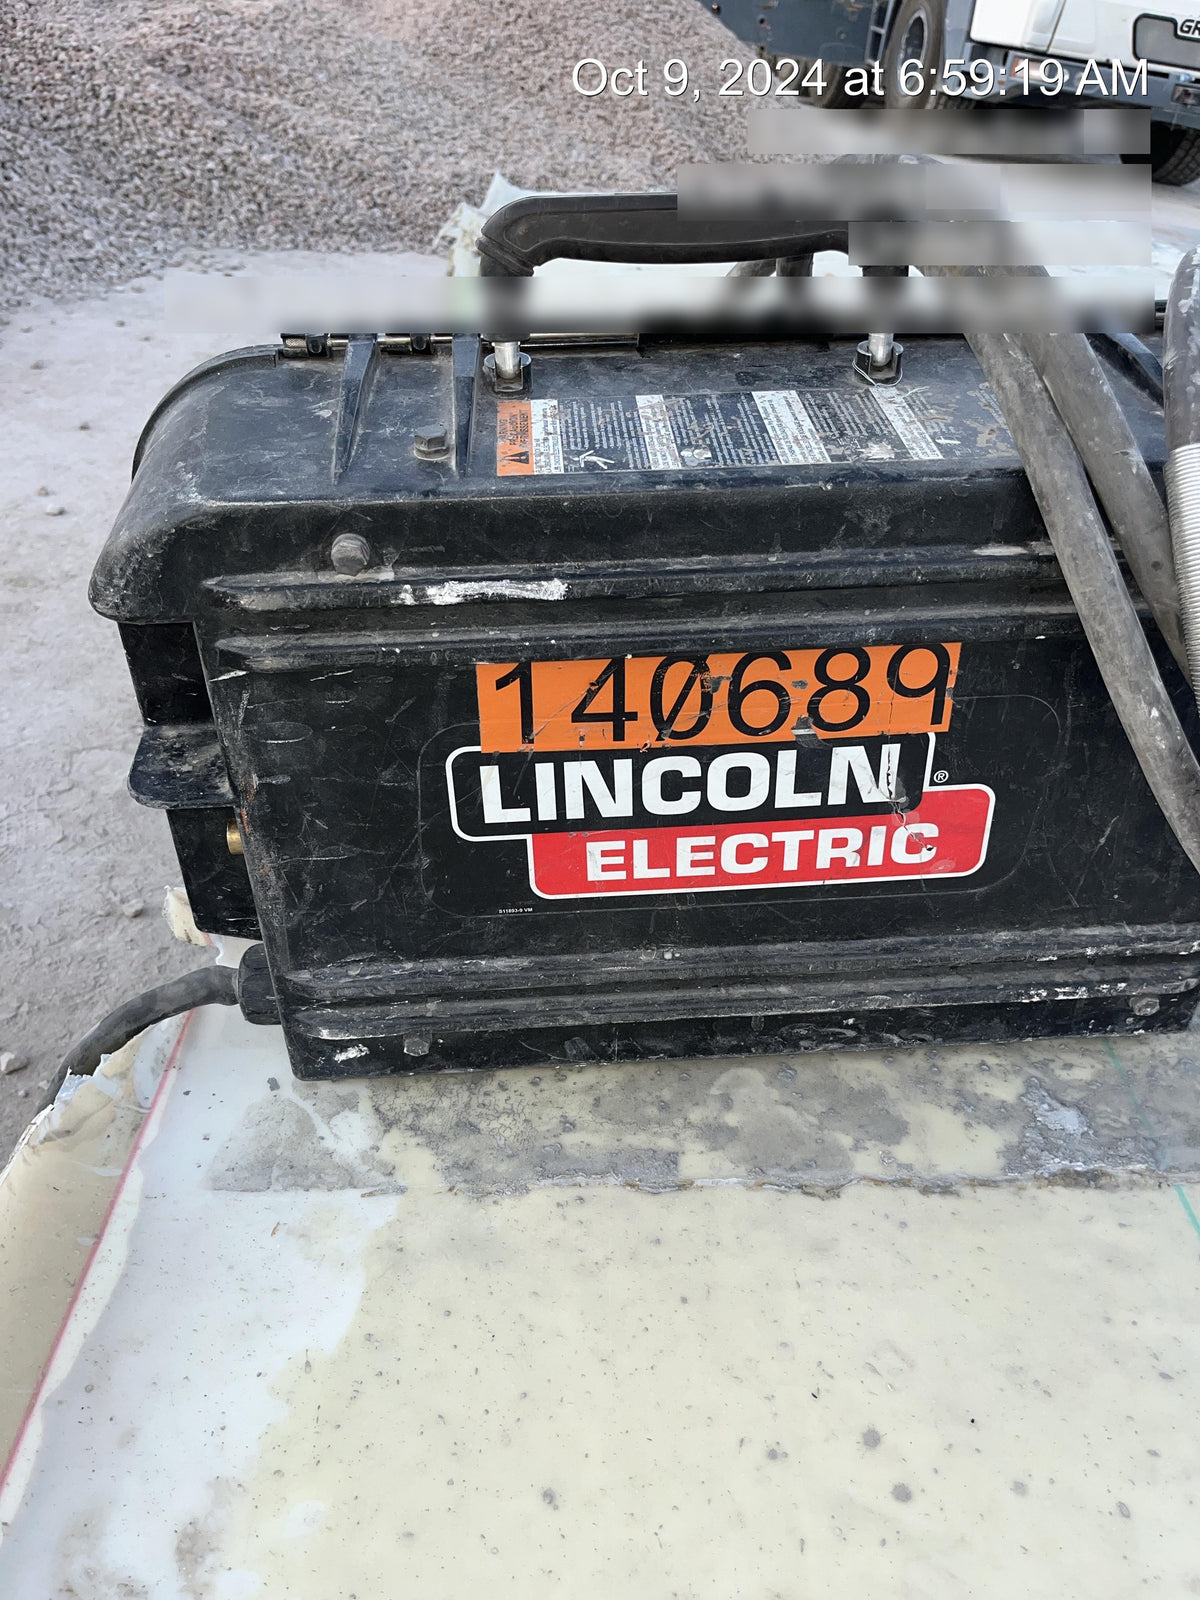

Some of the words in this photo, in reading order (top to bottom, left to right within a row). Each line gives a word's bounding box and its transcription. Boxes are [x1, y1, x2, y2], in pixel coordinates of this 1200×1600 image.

[494, 643, 951, 744] 140689
[479, 743, 901, 823] LINCOLN
[585, 822, 939, 882] ELECTRIC
